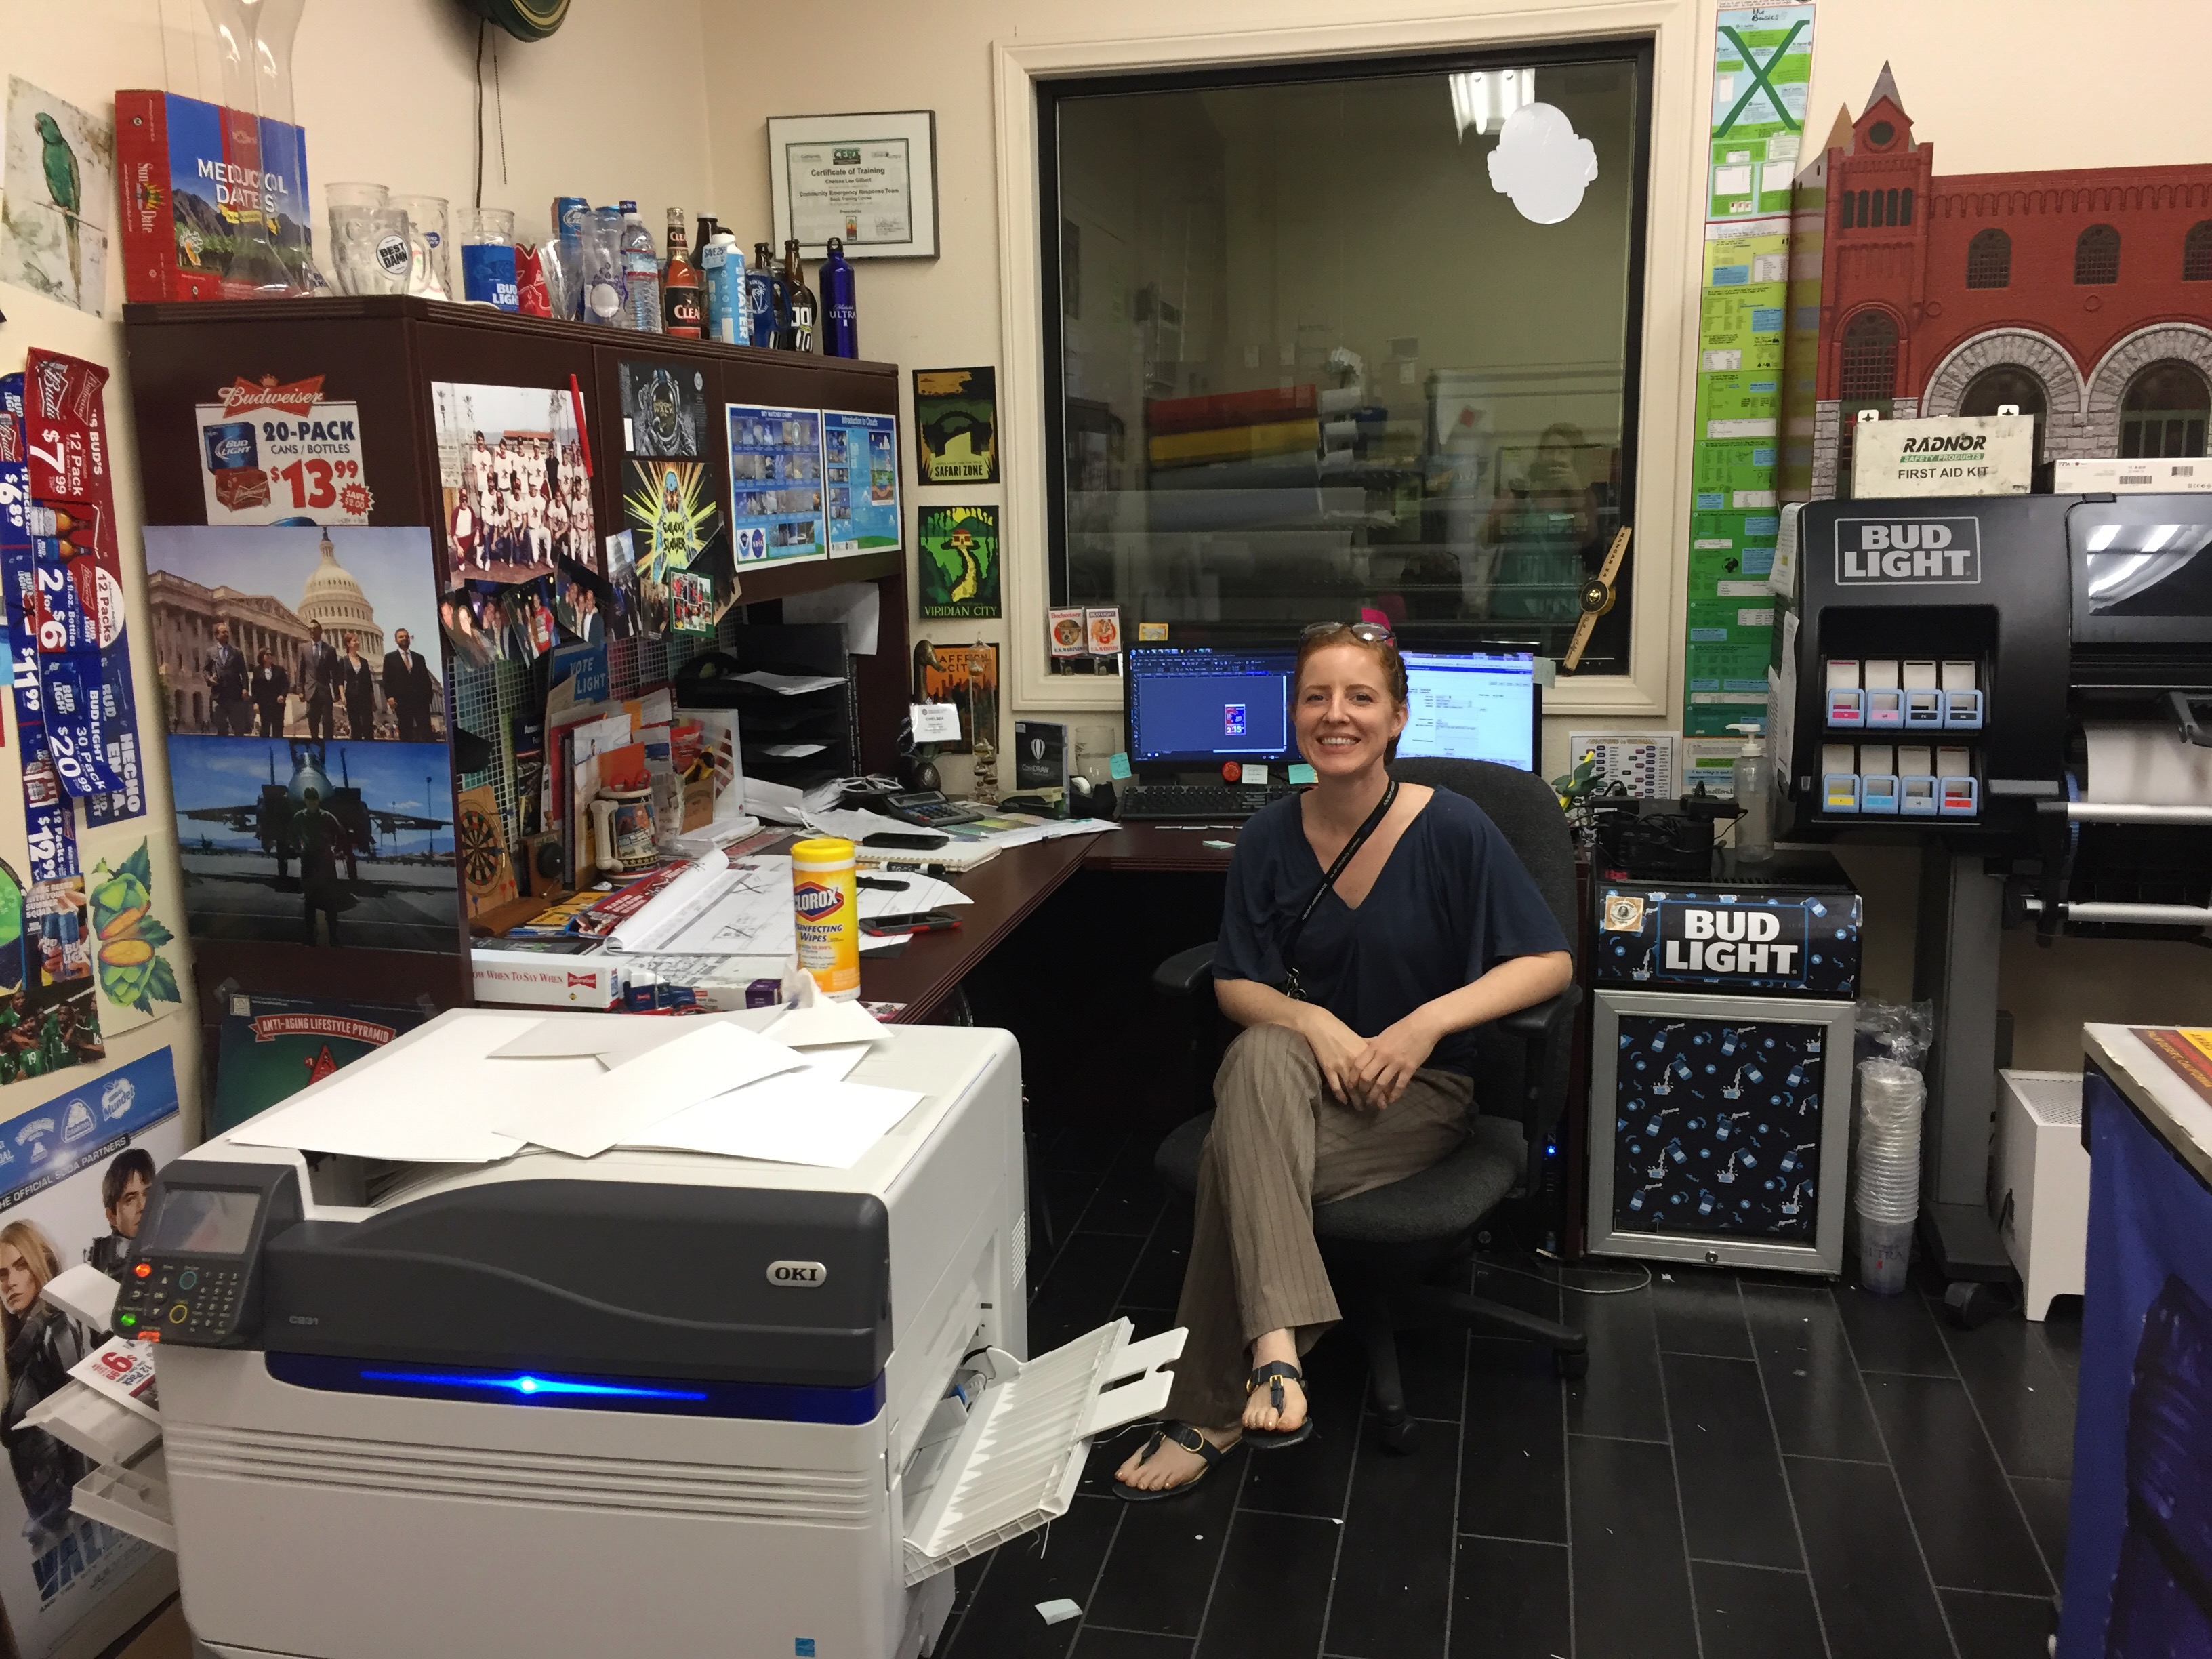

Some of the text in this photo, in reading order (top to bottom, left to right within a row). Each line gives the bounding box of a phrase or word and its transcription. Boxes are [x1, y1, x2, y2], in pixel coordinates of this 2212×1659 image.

[137, 163, 149, 182] Sun
[141, 209, 157, 233] Date
[380, 242, 405, 258] BEST
[383, 252, 409, 268] DAMN
[497, 283, 518, 294] BUD
[492, 293, 519, 305] LIGH
[737, 277, 749, 339] WATER
[830, 310, 856, 319] ULTRA
[80, 373, 97, 419] Budweiser
[218, 386, 323, 407] Budweiser
[841, 415, 862, 425] Introduction
[867, 417, 878, 426] Clouds
[263, 421, 356, 441] 20-PACK
[222, 445, 251, 455] LIGHT
[226, 439, 248, 447] BUD
[271, 445, 298, 455] CANS
[307, 443, 350, 454] BOTTLES
[1902, 436, 1987, 453] RADNOR
[89, 431, 103, 476] BUD'S
[1903, 453, 1982, 463] SAFETY PRODUCTS
[70, 432, 83, 496] 12 Pack
[334, 459, 359, 478] 99
[935, 465, 983, 476] SAFARI ZONE
[1898, 466, 1989, 480] FIRST AID KIT
[56, 476, 66, 494] 99
[346, 491, 365, 501] SAVE
[9, 504, 23, 527] 89
[663, 521, 685, 536] GALAXY
[1860, 526, 1952, 550] BUD
[663, 537, 687, 554] SLAYER
[1844, 550, 1971, 577] LIGHT
[38, 568, 64, 591] 2
[44, 594, 52, 613] for
[98, 573, 112, 642] 12 Packs
[925, 606, 997, 616] VIRIDIAN CITY
[570, 657, 594, 676] VOTE
[938, 653, 989, 663] AFFRON
[576, 672, 606, 695] LIGHT
[25, 689, 40, 710] 99
[53, 682, 68, 715] LIGHT
[62, 684, 75, 712] BUD
[89, 689, 104, 763] BUD LIGHT
[76, 726, 106, 791] 30 Pack
[119, 733, 141, 813] HECHO
[79, 777, 94, 792] 99
[52, 808, 66, 863] 12 Packs
[1311, 882, 1328, 907] AEROSPACE
[1684, 909, 1780, 942] BUD
[800, 932, 827, 942] WIPES
[1666, 940, 1798, 975] LIGHT
[487, 970, 563, 983] WHEN TO SAY WHEN
[93, 1033, 102, 1045] 16
[262, 1017, 389, 1043] ANTI-AGING LIFESTYLE PYRAMID
[26, 1051, 37, 1066] 19
[102, 1085, 136, 1122] Mundet
[13, 1176, 53, 1202] OFFICIAL
[54, 1161, 81, 1180] SODA
[81, 1136, 127, 1166] PARTNERS
[775, 1267, 818, 1282] OKI
[121, 1371, 144, 1387] Pack
